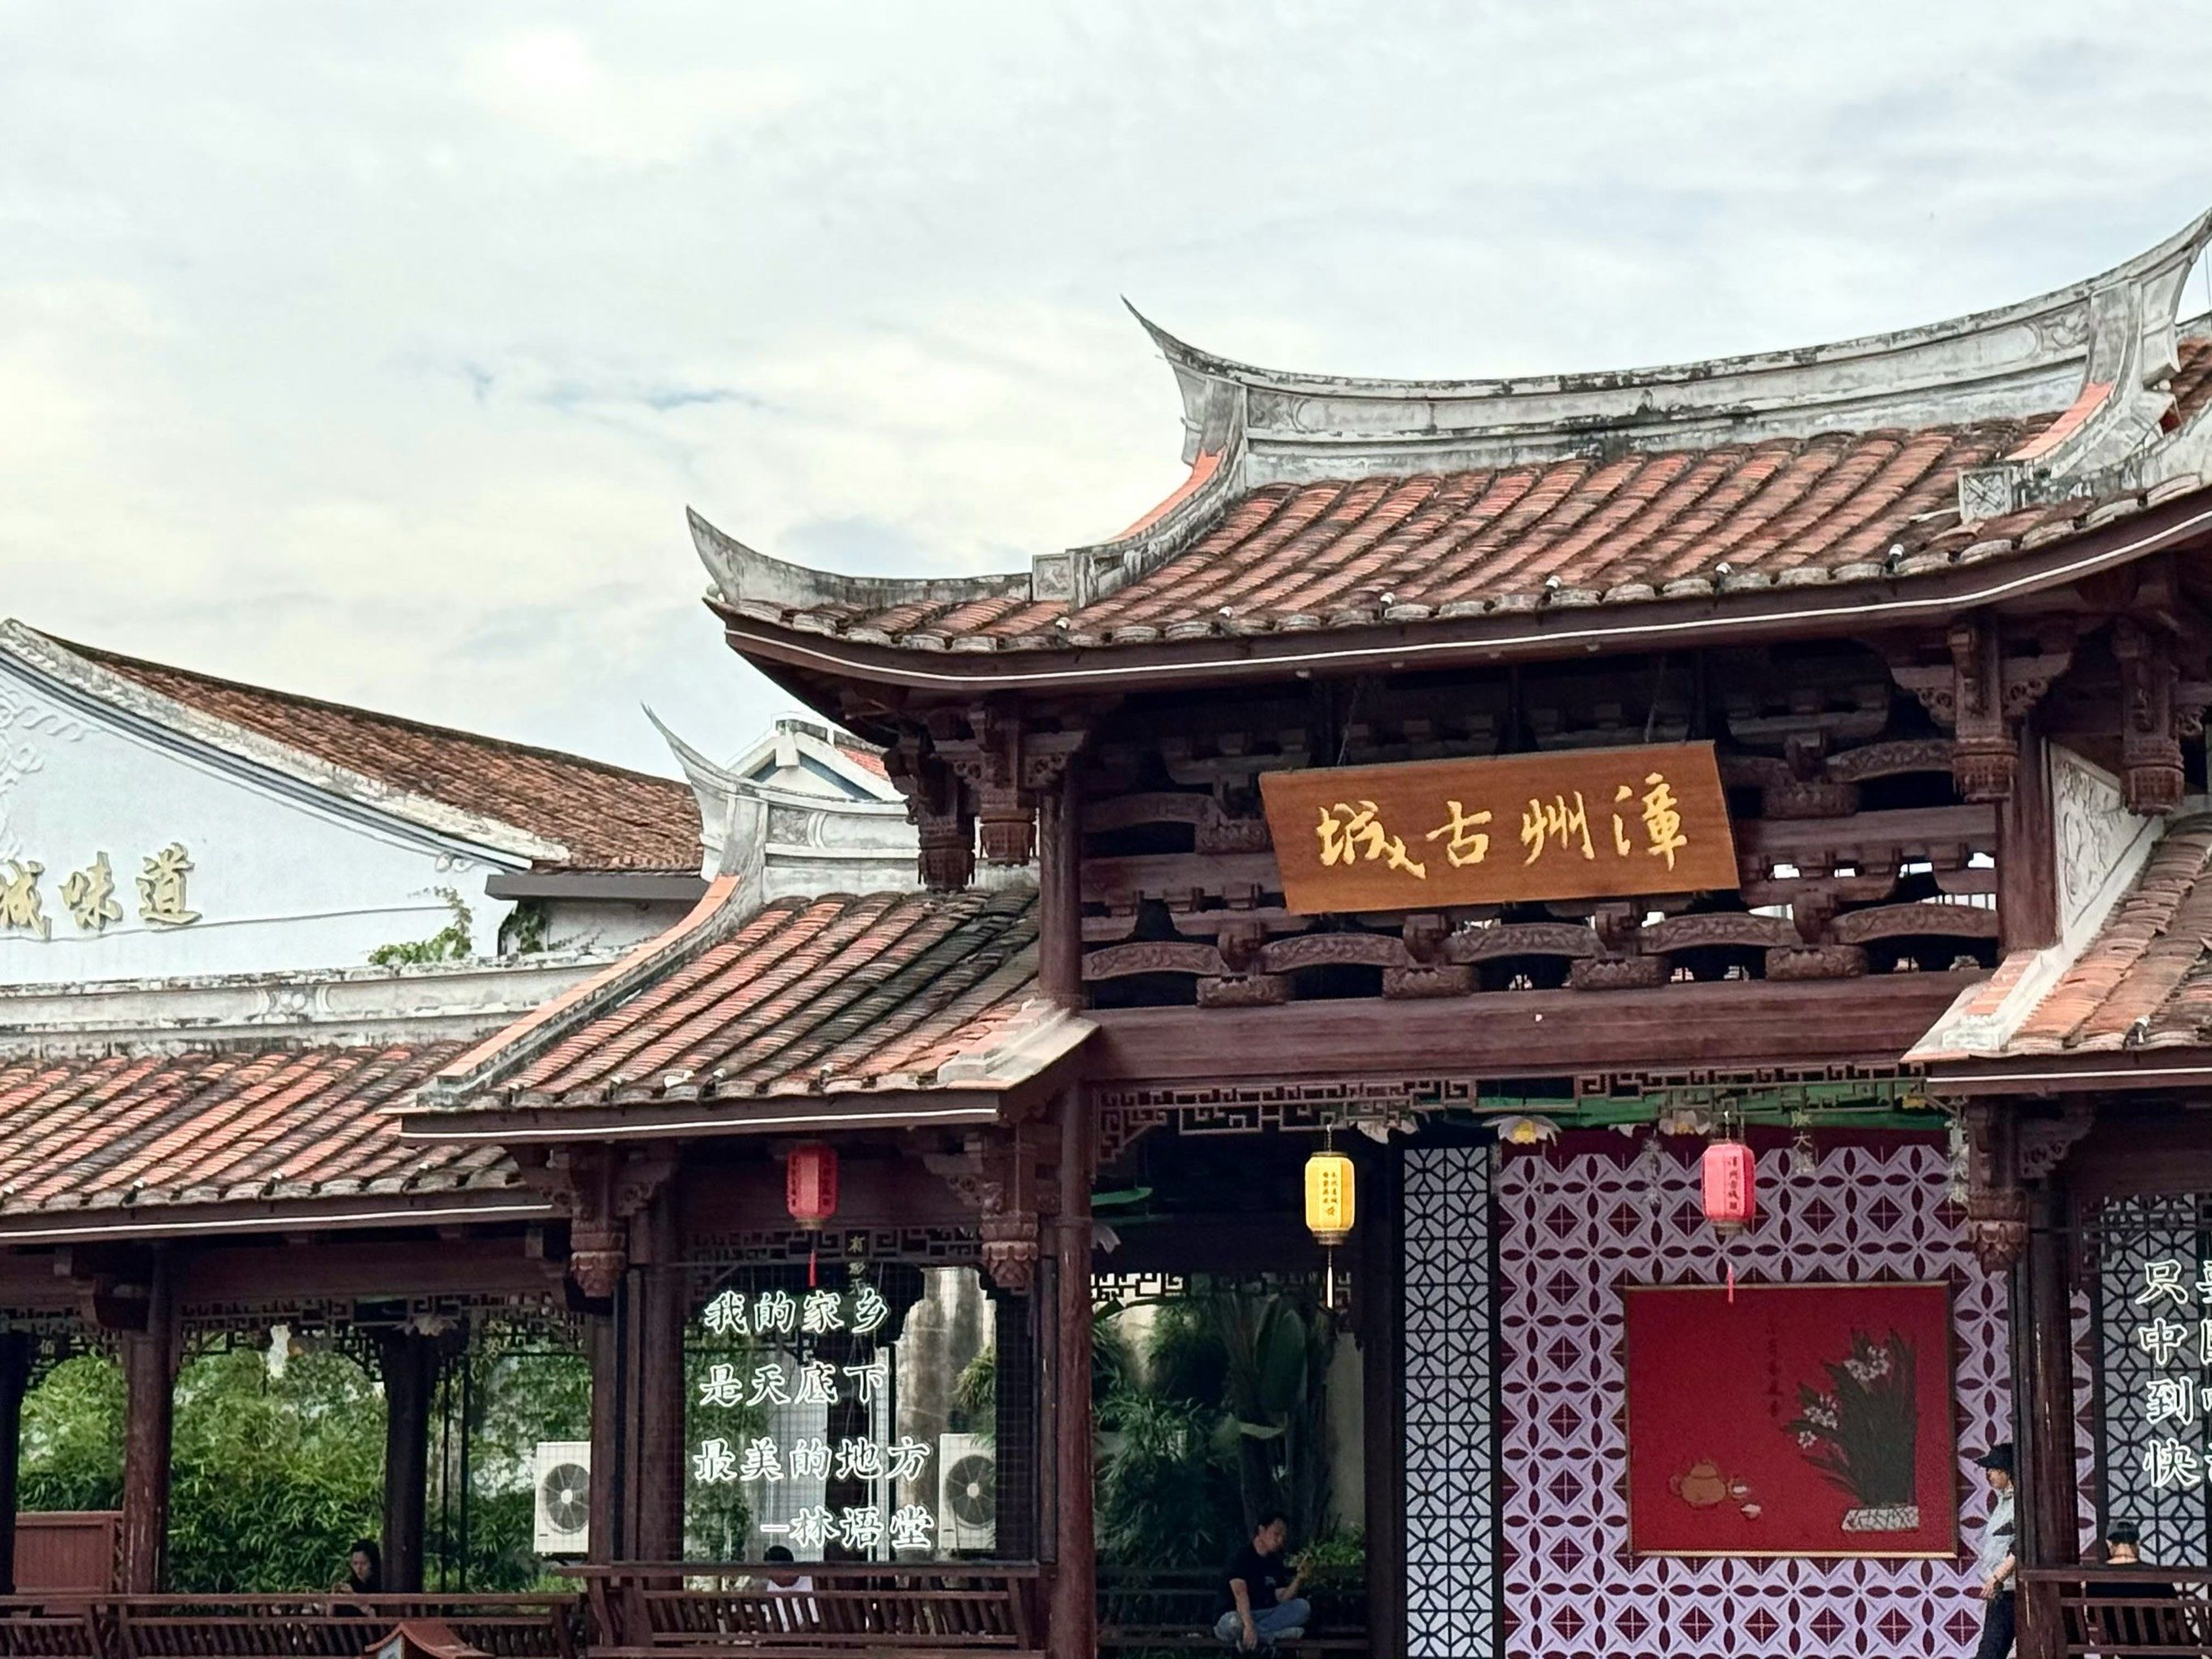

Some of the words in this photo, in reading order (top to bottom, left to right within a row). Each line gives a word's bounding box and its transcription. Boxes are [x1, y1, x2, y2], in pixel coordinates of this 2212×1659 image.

[703, 1287, 889, 1334] 我的家乡
[699, 1361, 888, 1407] 是天底下
[2146, 1376, 2212, 1426] 到
[693, 1435, 930, 1482] 最美的地方
[2142, 1438, 2212, 1488] 快
